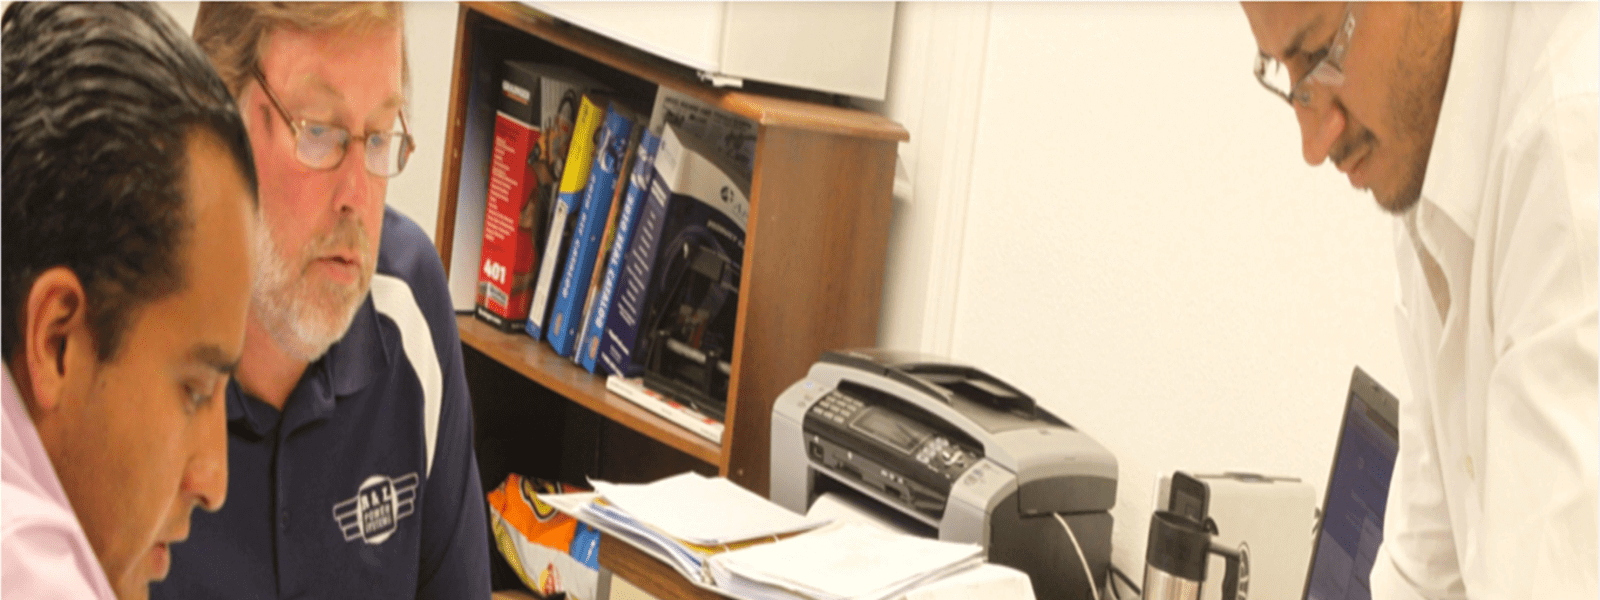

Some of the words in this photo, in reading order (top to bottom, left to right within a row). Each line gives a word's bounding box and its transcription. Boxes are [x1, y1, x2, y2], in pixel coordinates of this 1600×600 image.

[484, 258, 506, 285] 401
[594, 267, 615, 330] CATALOG
[382, 486, 392, 502] L
